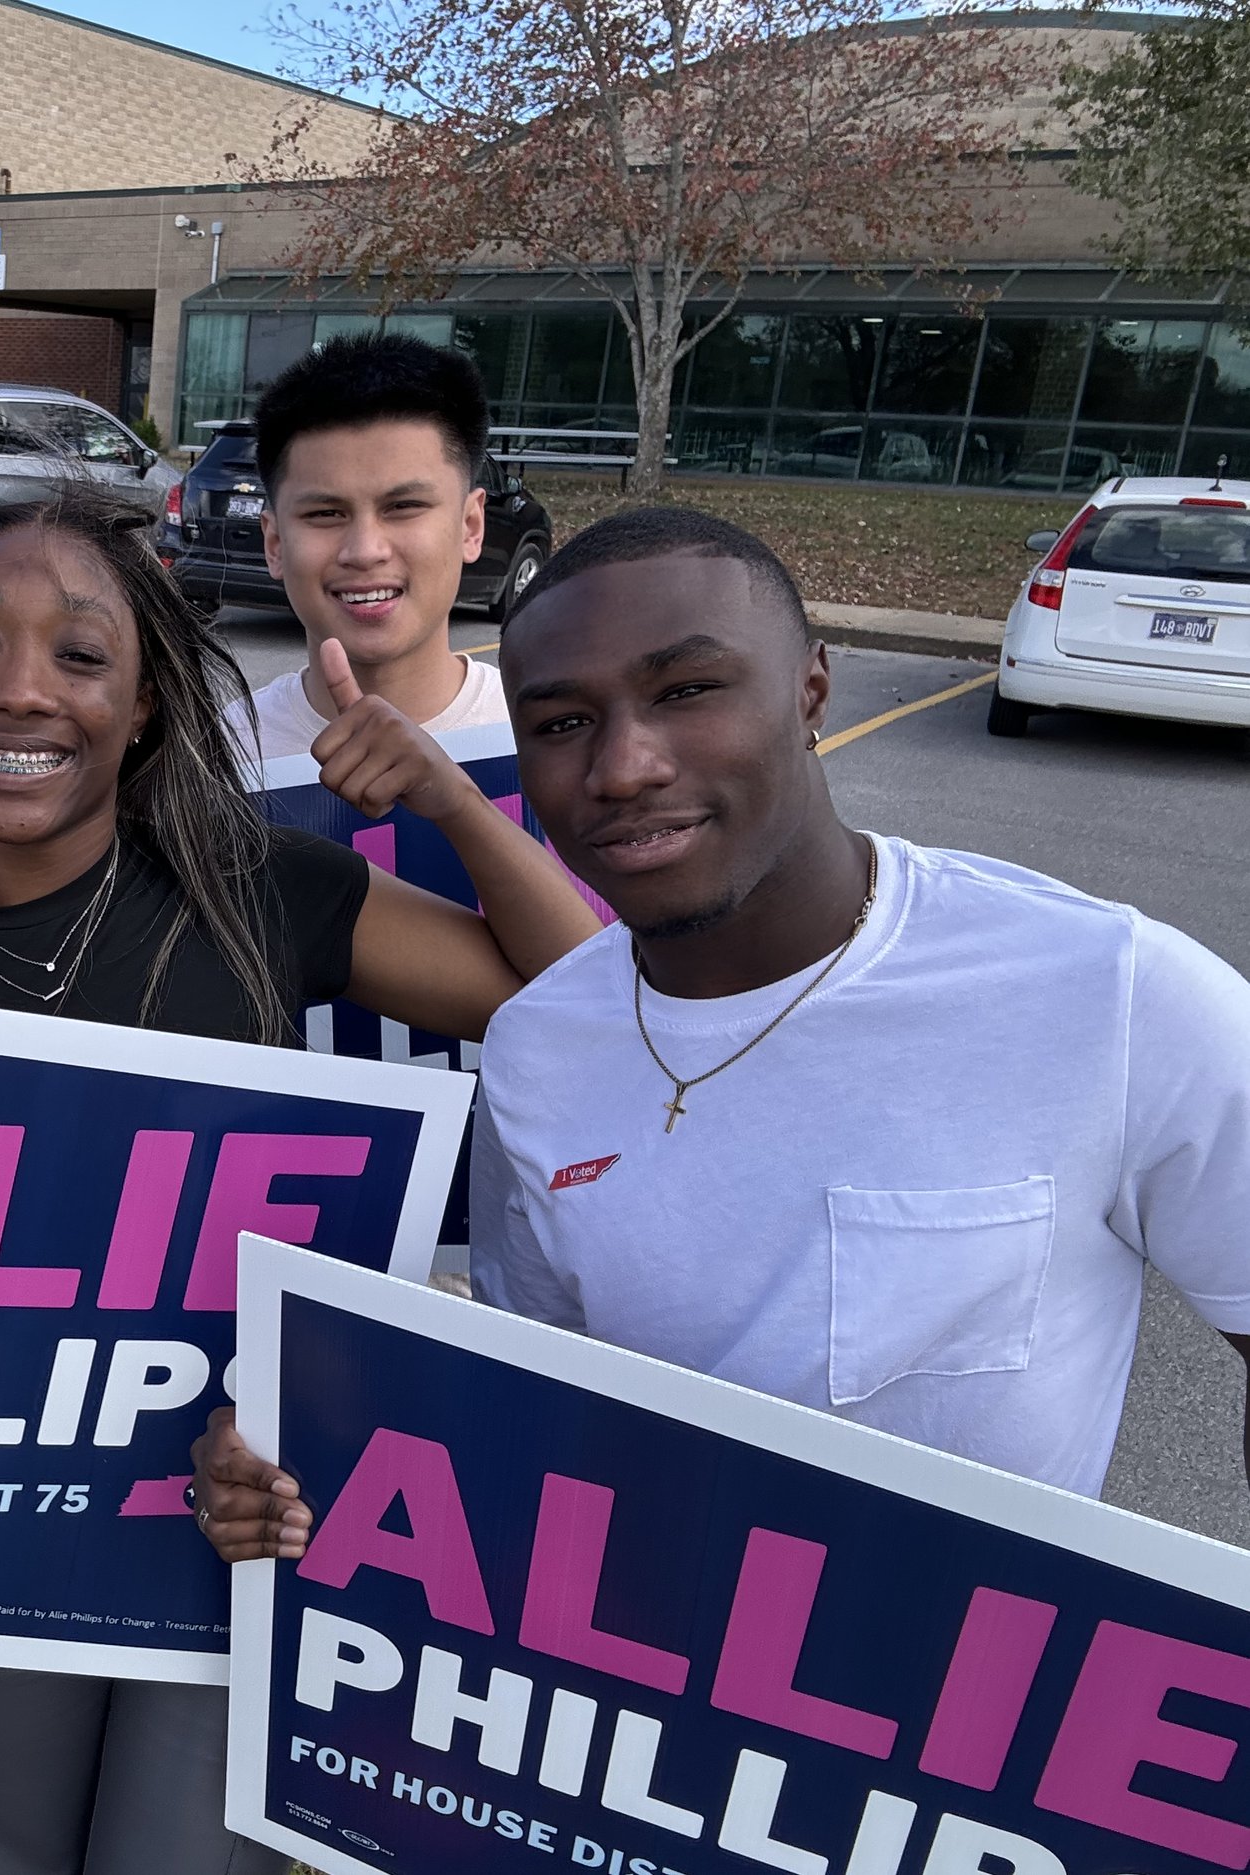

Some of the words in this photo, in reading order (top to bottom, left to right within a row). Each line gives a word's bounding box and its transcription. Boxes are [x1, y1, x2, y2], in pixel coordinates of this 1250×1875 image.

[1152, 619, 1175, 634] 148
[1184, 621, 1214, 638] BDVT
[562, 1170, 567, 1182] I
[569, 1163, 597, 1178] Voted
[34, 1484, 91, 1515] 75
[18, 1606, 31, 1617] for
[35, 1608, 46, 1620] by
[48, 1610, 68, 1621] Allie
[71, 1612, 102, 1624] Phillips
[105, 1614, 120, 1625] for
[122, 1616, 156, 1629] Change
[165, 1619, 211, 1633] Treasurer:
[296, 1427, 1250, 1871] ALLIE
[289, 1735, 380, 1790] FOR
[392, 1771, 559, 1854] HOUSE
